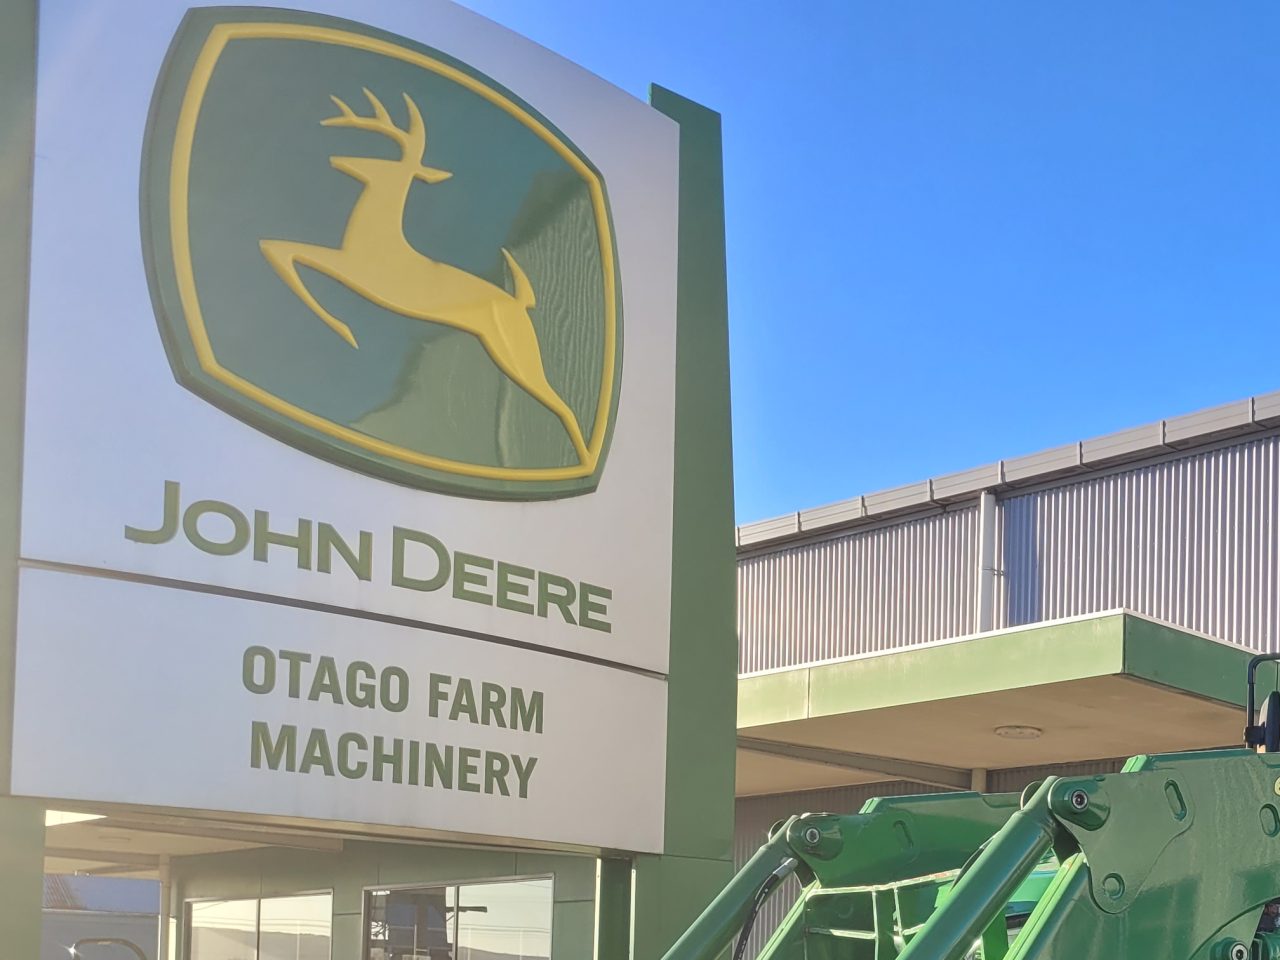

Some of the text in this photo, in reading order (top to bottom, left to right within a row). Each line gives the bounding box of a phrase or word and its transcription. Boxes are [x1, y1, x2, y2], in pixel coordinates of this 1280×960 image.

[124, 479, 613, 634] JOHN DEERE
[242, 645, 544, 734] OTAGO FARM
[250, 720, 538, 799] MACHINERY
